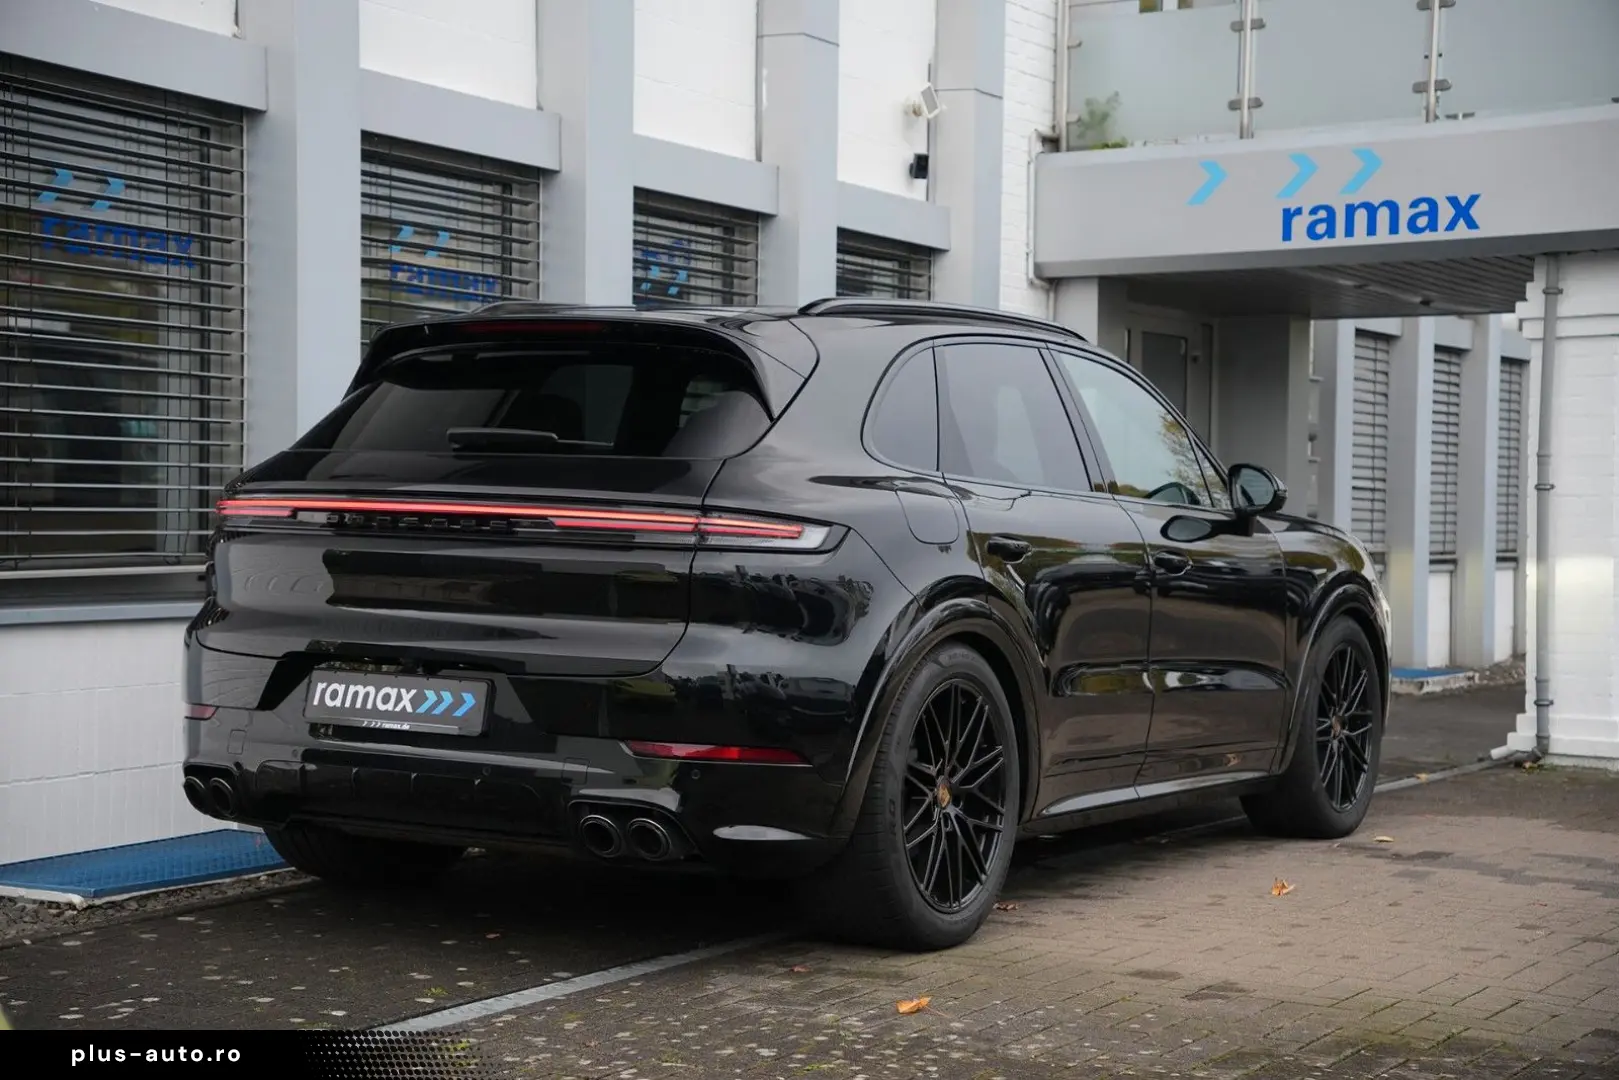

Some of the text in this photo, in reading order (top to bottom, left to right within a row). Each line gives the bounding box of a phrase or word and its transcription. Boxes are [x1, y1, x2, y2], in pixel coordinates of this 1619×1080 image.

[1281, 193, 1481, 242] ramax
[312, 681, 418, 714] ramax
[381, 722, 411, 731] ramax.de
